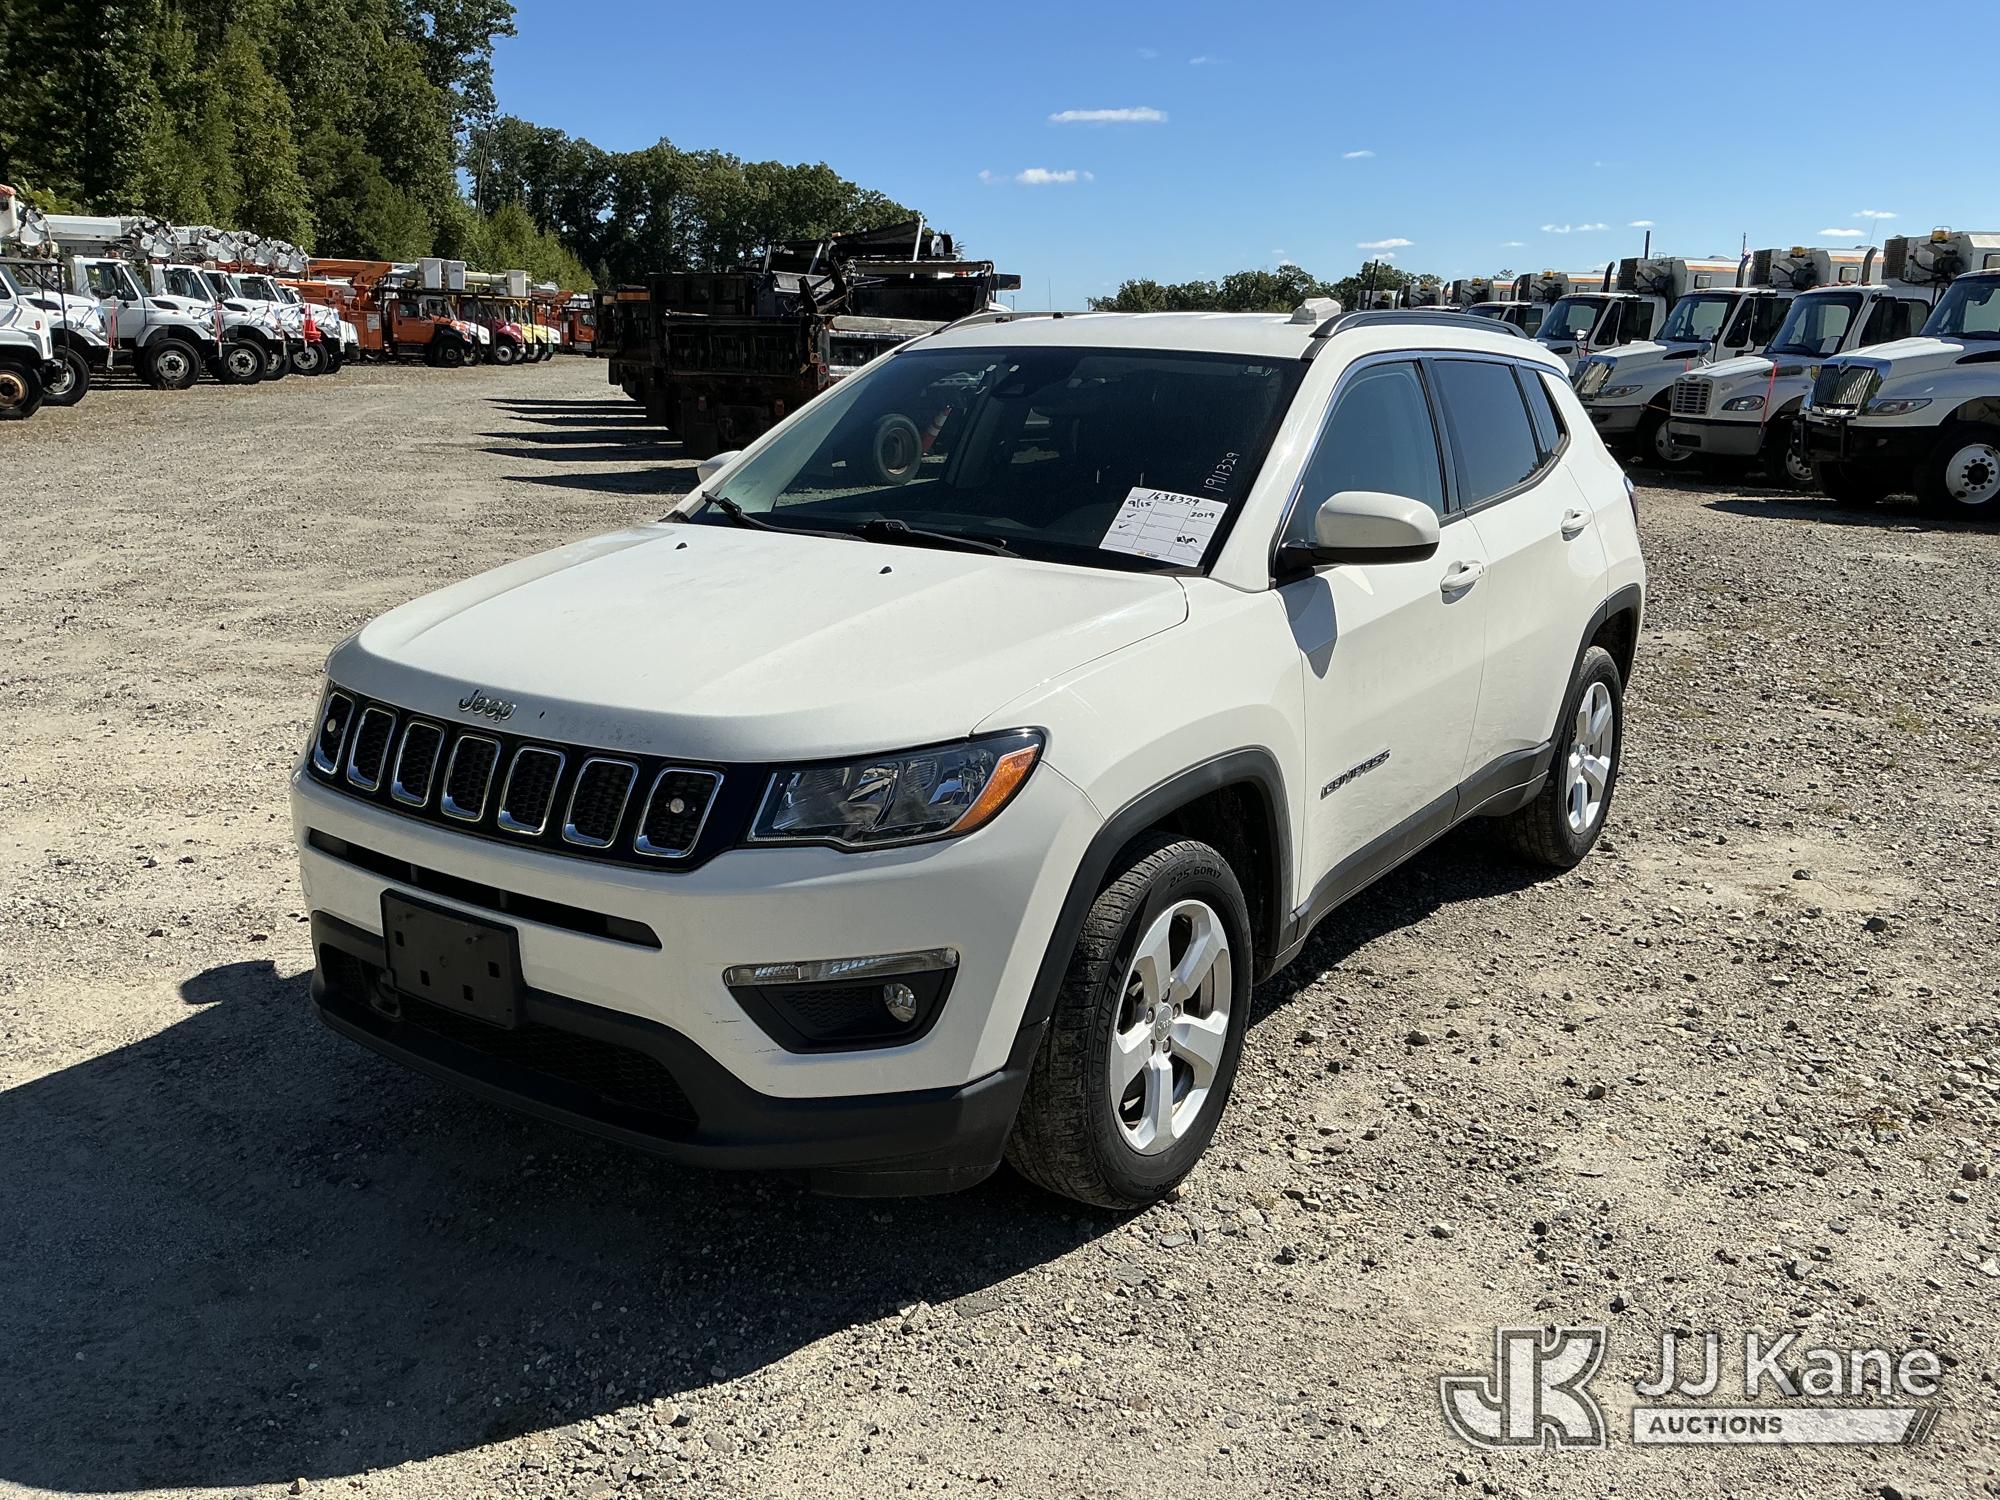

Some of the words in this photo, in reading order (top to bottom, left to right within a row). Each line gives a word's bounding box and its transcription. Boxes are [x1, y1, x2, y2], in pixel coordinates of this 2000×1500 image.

[1190, 511, 1216, 519] 2019
[459, 689, 517, 724] Jeep
[1320, 748, 1391, 800] COMPASS
